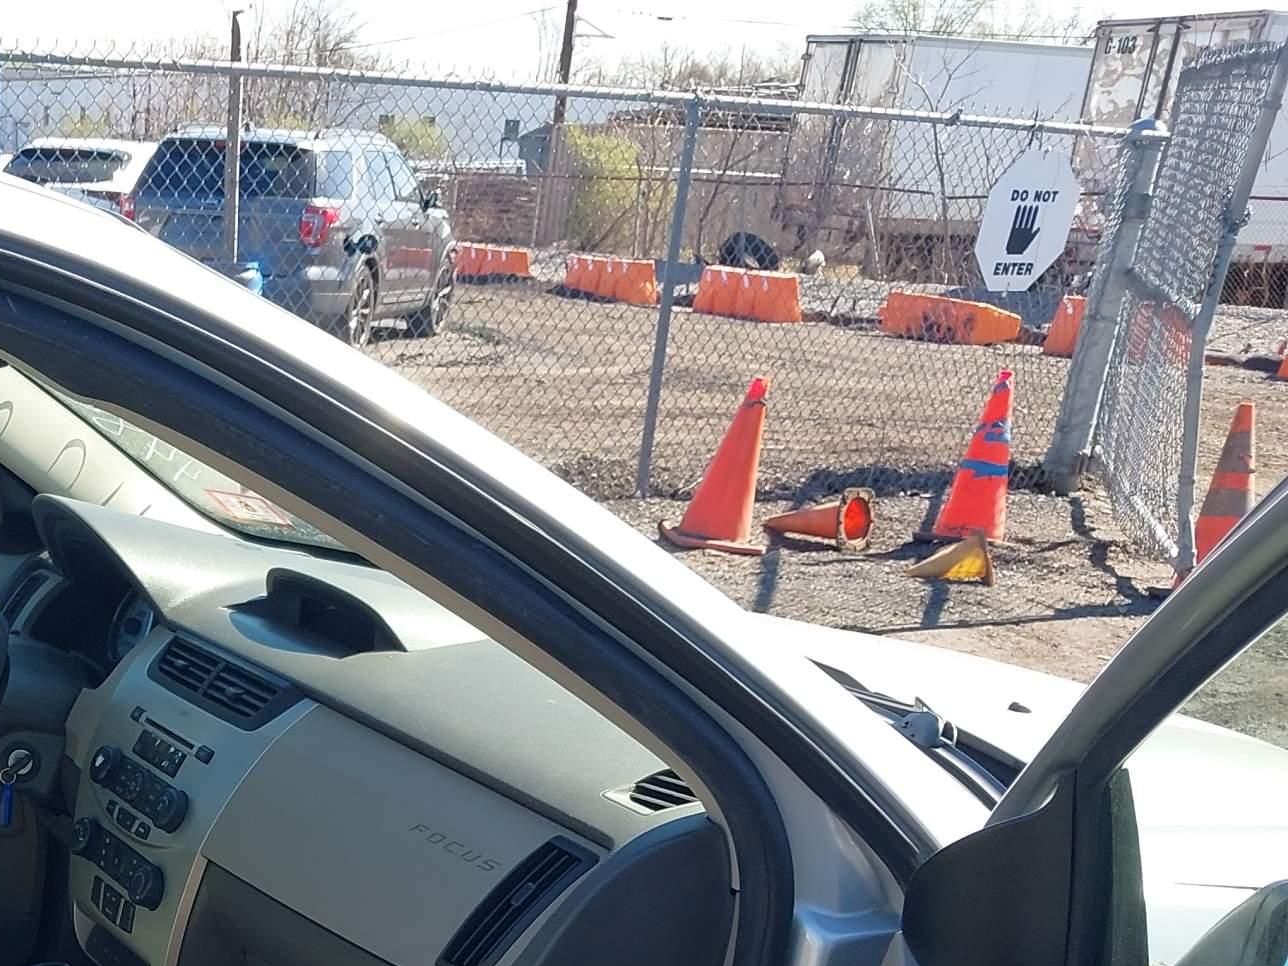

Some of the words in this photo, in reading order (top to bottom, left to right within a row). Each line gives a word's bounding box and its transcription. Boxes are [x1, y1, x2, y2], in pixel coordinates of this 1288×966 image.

[1104, 36, 1138, 55] G-103
[1010, 189, 1029, 202] DO
[1033, 190, 1059, 203] NOT
[992, 262, 1034, 276] ENTER
[408, 823, 502, 872] FOCUS
